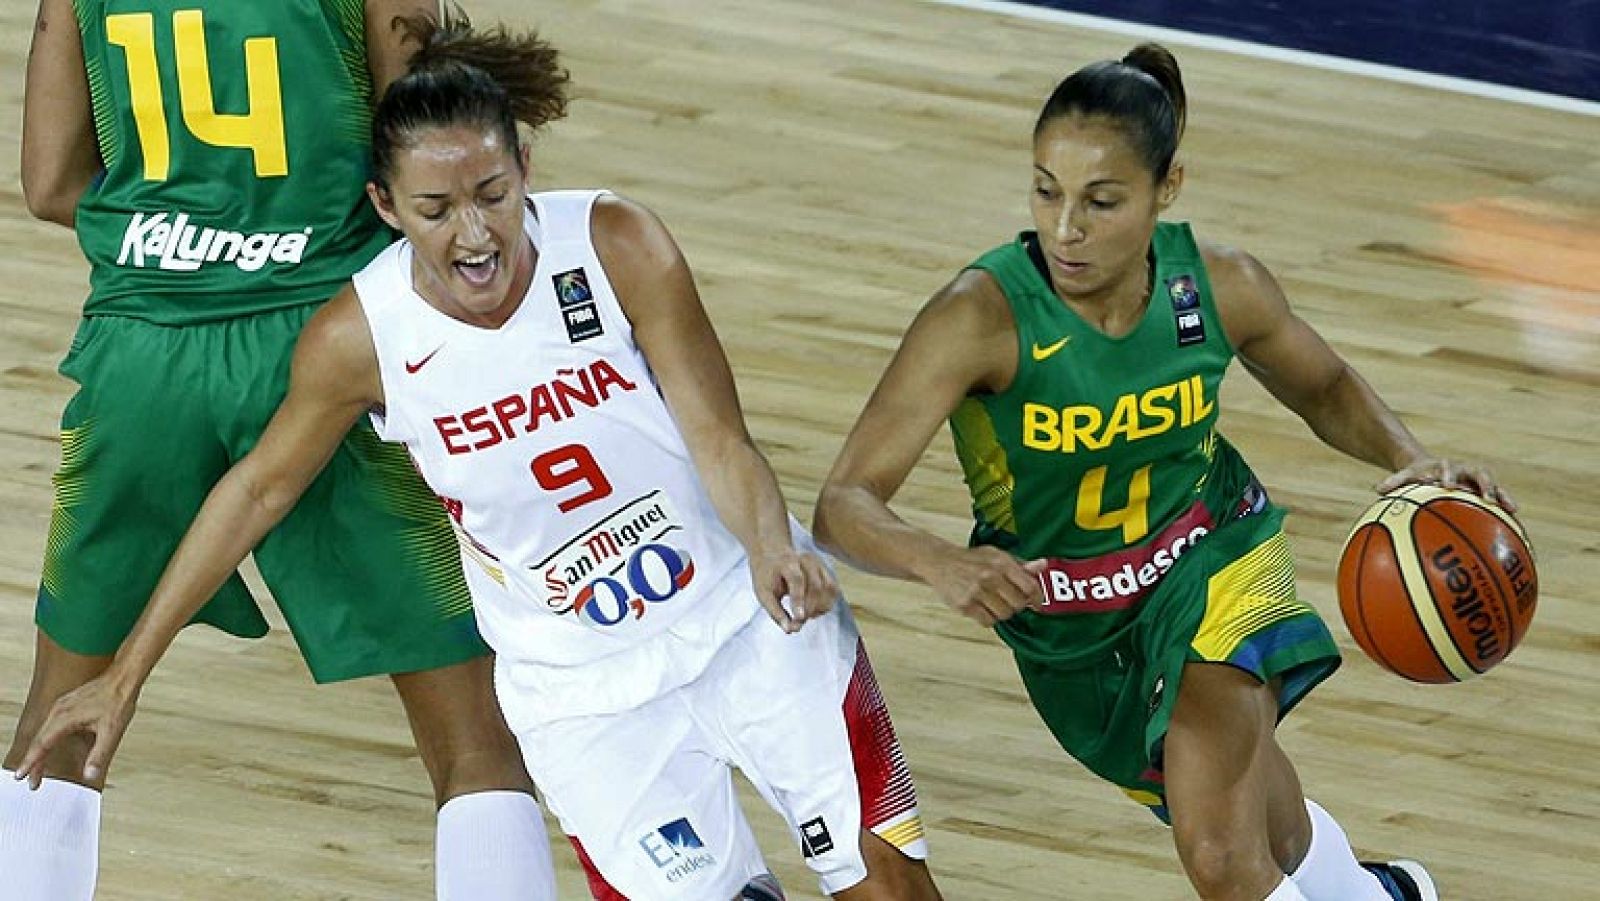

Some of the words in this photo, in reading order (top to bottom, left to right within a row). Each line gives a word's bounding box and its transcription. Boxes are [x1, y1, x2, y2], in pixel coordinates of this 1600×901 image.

[106, 10, 288, 181] 14
[433, 359, 637, 455] ESPAÑA
[1022, 374, 1216, 453] BRASIL
[531, 443, 613, 514] 9
[1075, 463, 1153, 545] 4
[1433, 545, 1499, 660] molten
